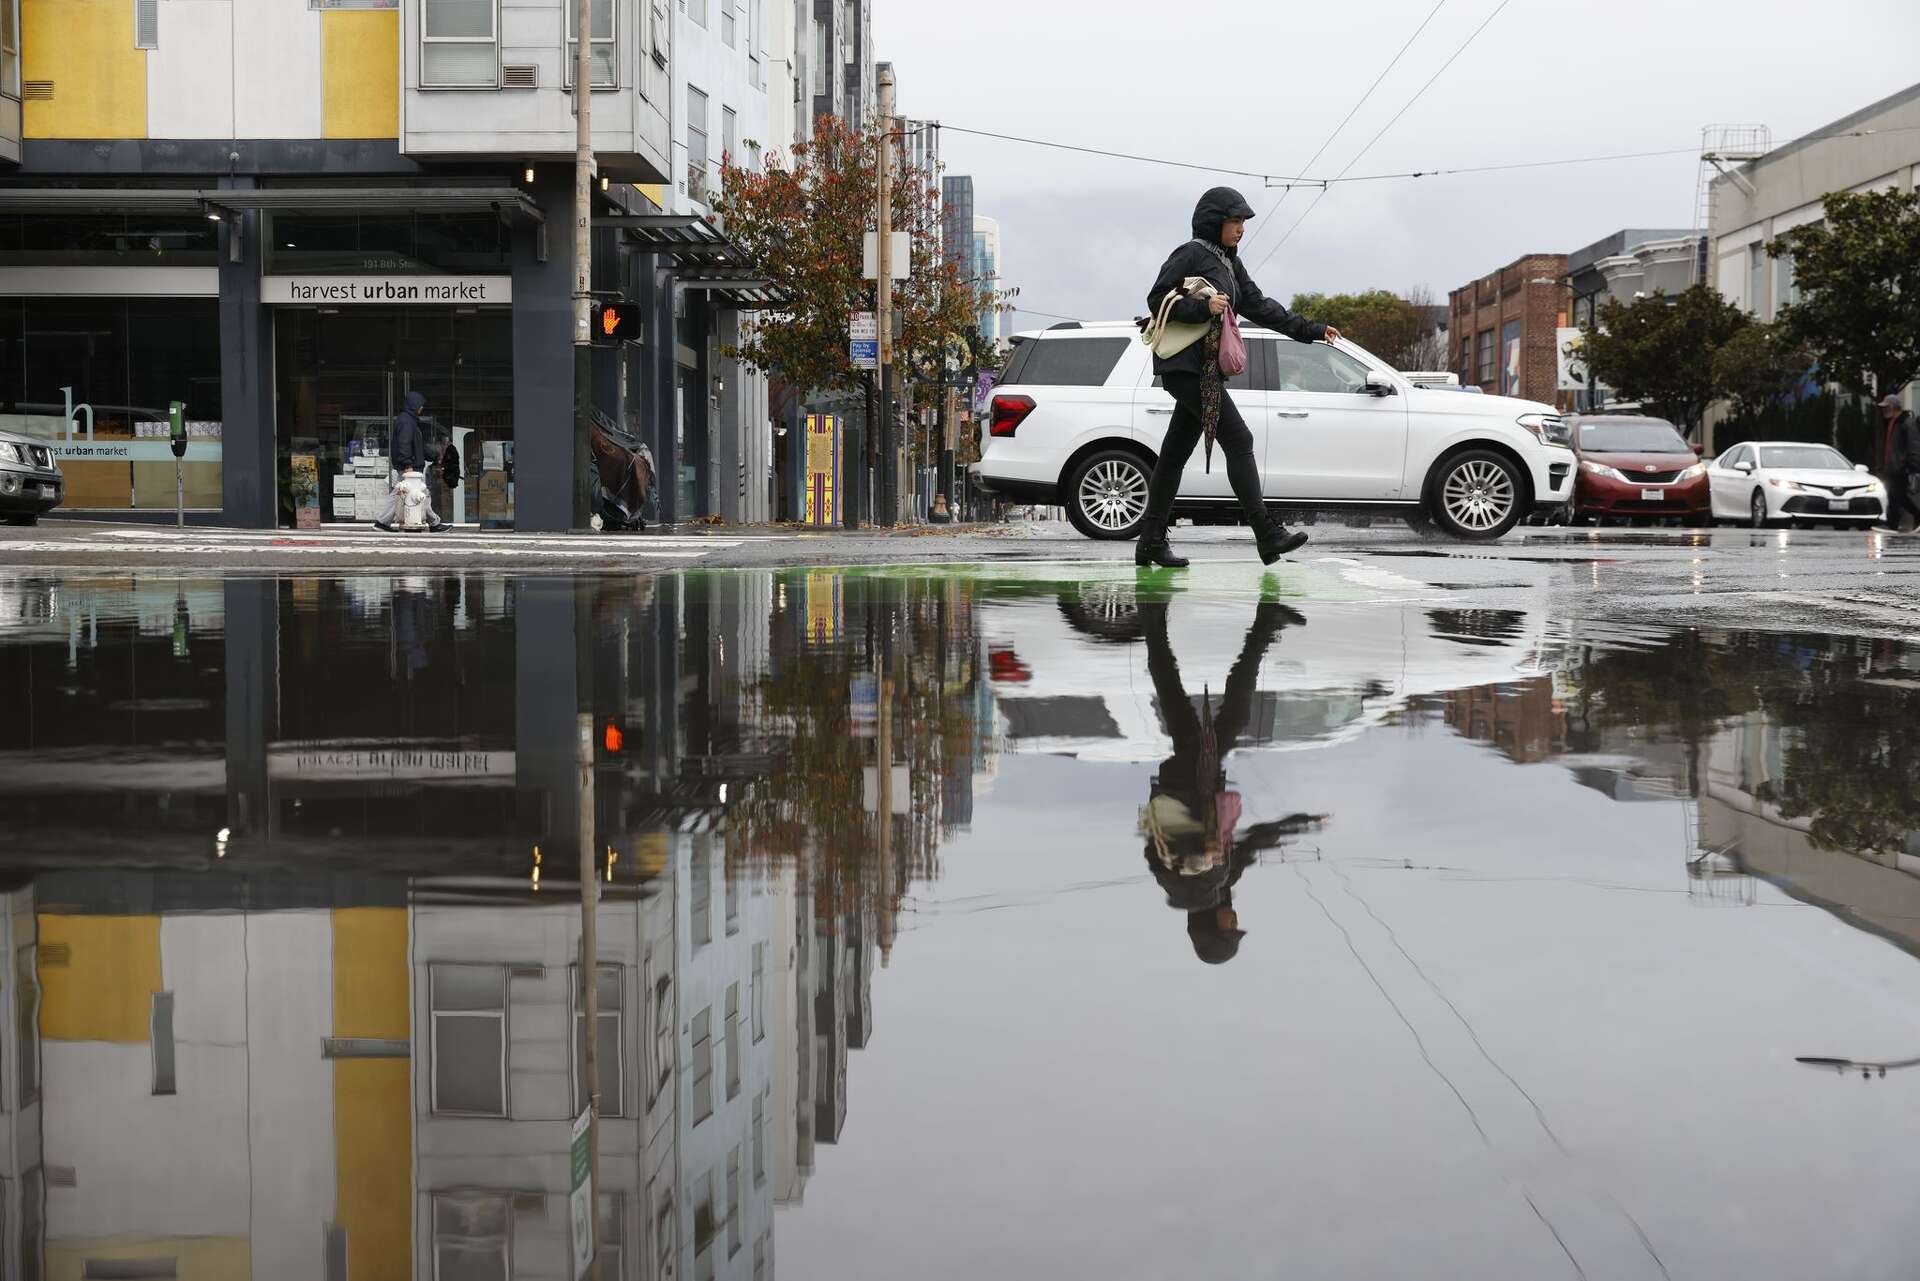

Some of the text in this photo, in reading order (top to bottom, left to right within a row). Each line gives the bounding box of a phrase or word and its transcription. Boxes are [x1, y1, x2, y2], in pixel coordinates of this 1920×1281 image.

[291, 281, 486, 299] harvest urban market
[65, 446, 94, 456] urban
[96, 446, 128, 456] market
